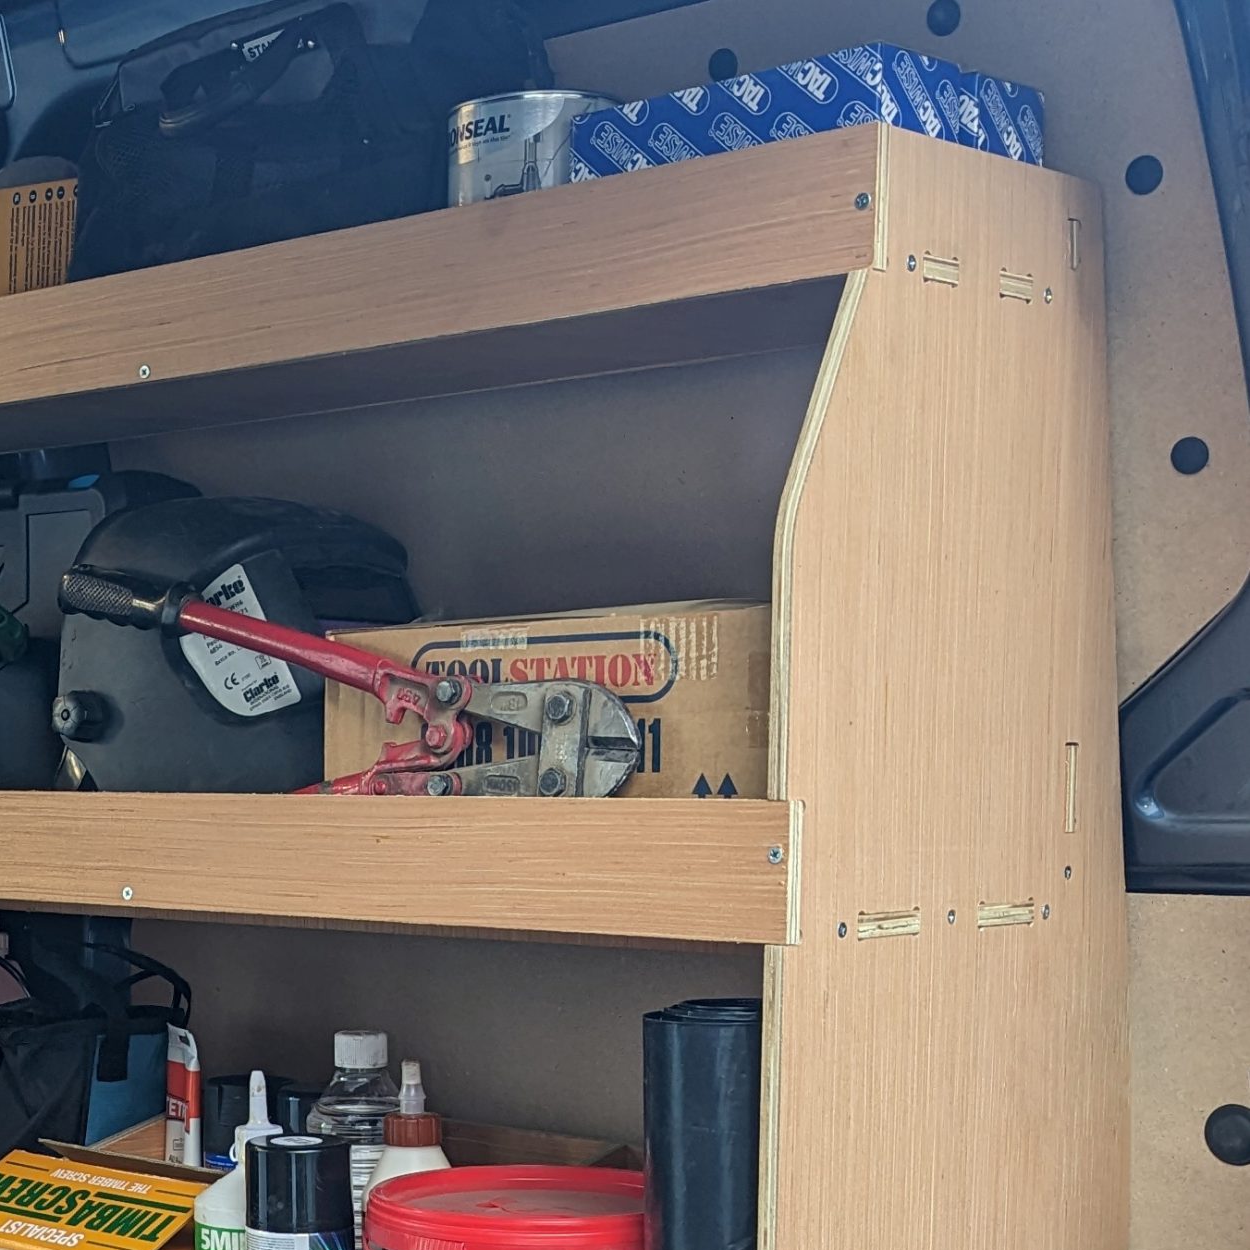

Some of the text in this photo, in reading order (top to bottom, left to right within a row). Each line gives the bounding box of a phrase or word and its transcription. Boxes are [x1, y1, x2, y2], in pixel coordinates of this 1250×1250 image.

[450, 114, 511, 147] ONSEAL
[50, 1168, 152, 1194] THE TIMBER SCREW
